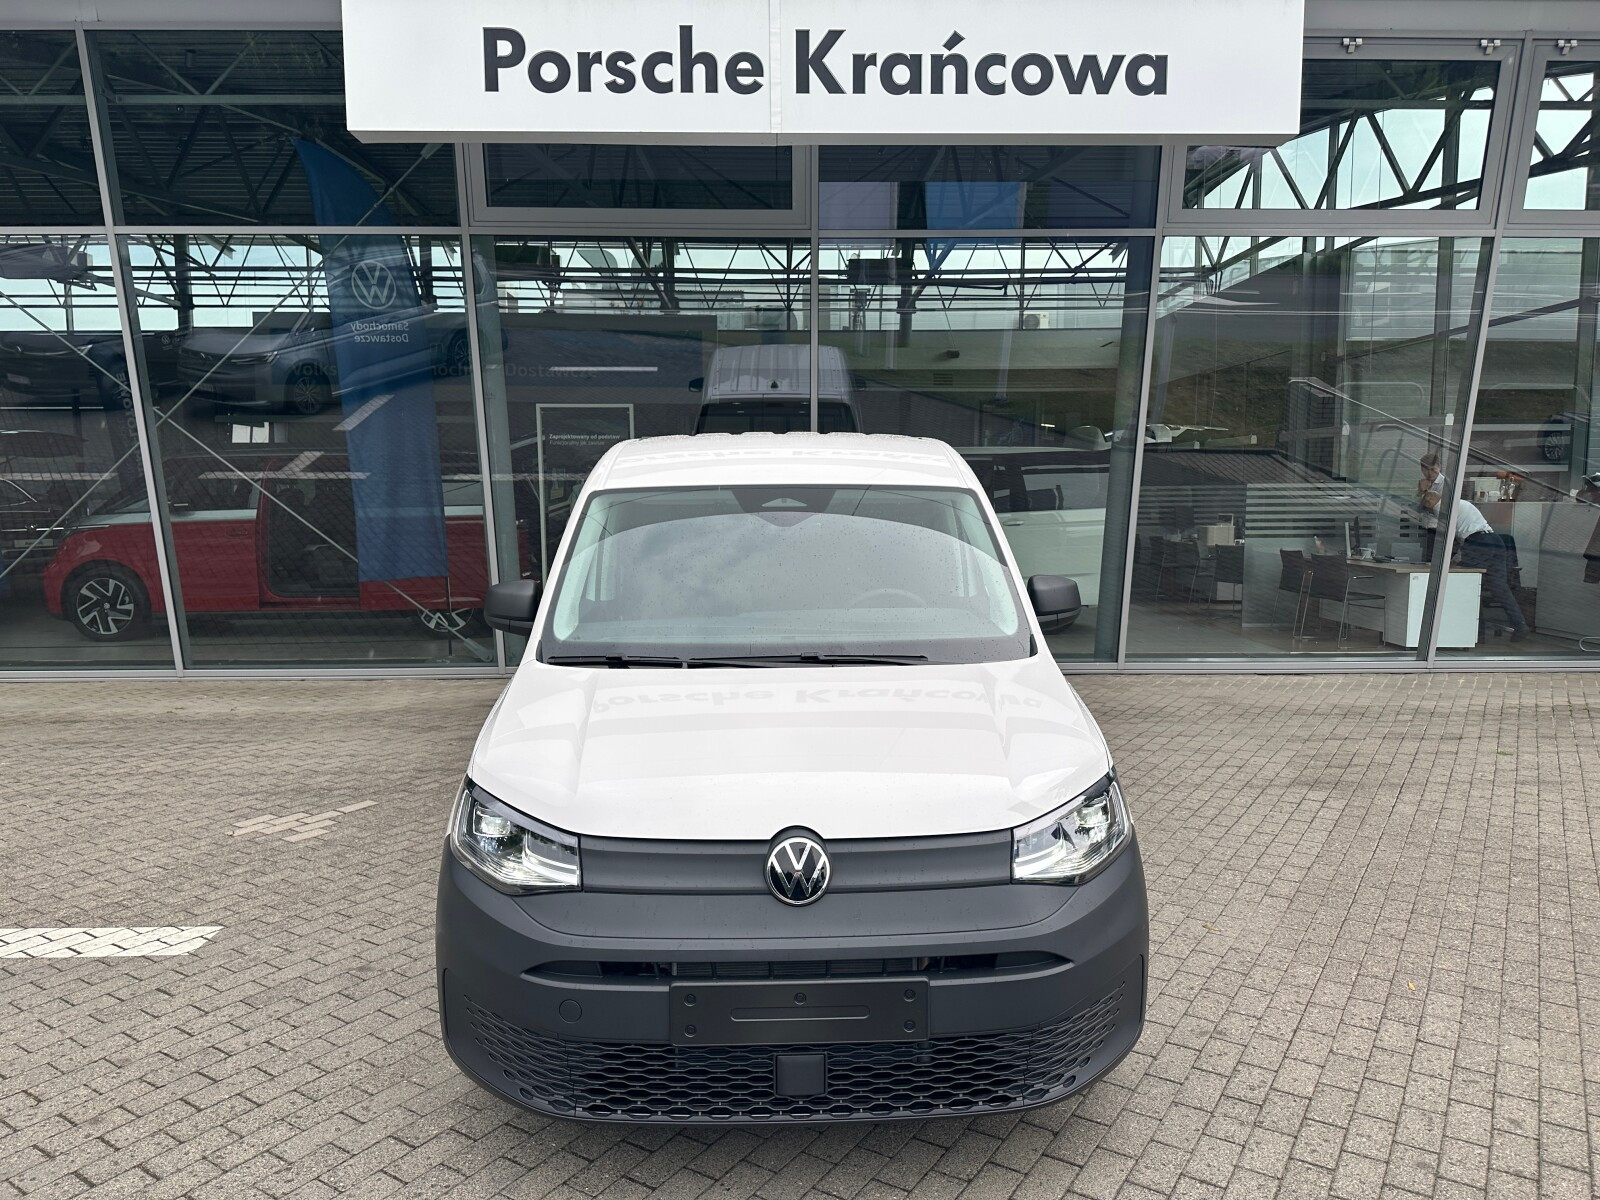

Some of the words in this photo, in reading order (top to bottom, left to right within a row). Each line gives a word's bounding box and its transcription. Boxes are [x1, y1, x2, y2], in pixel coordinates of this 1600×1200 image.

[482, 25, 764, 94] Porsche
[794, 30, 1168, 96] Krańcowa
[293, 362, 338, 376] Volks
[767, 836, 831, 905] VW
